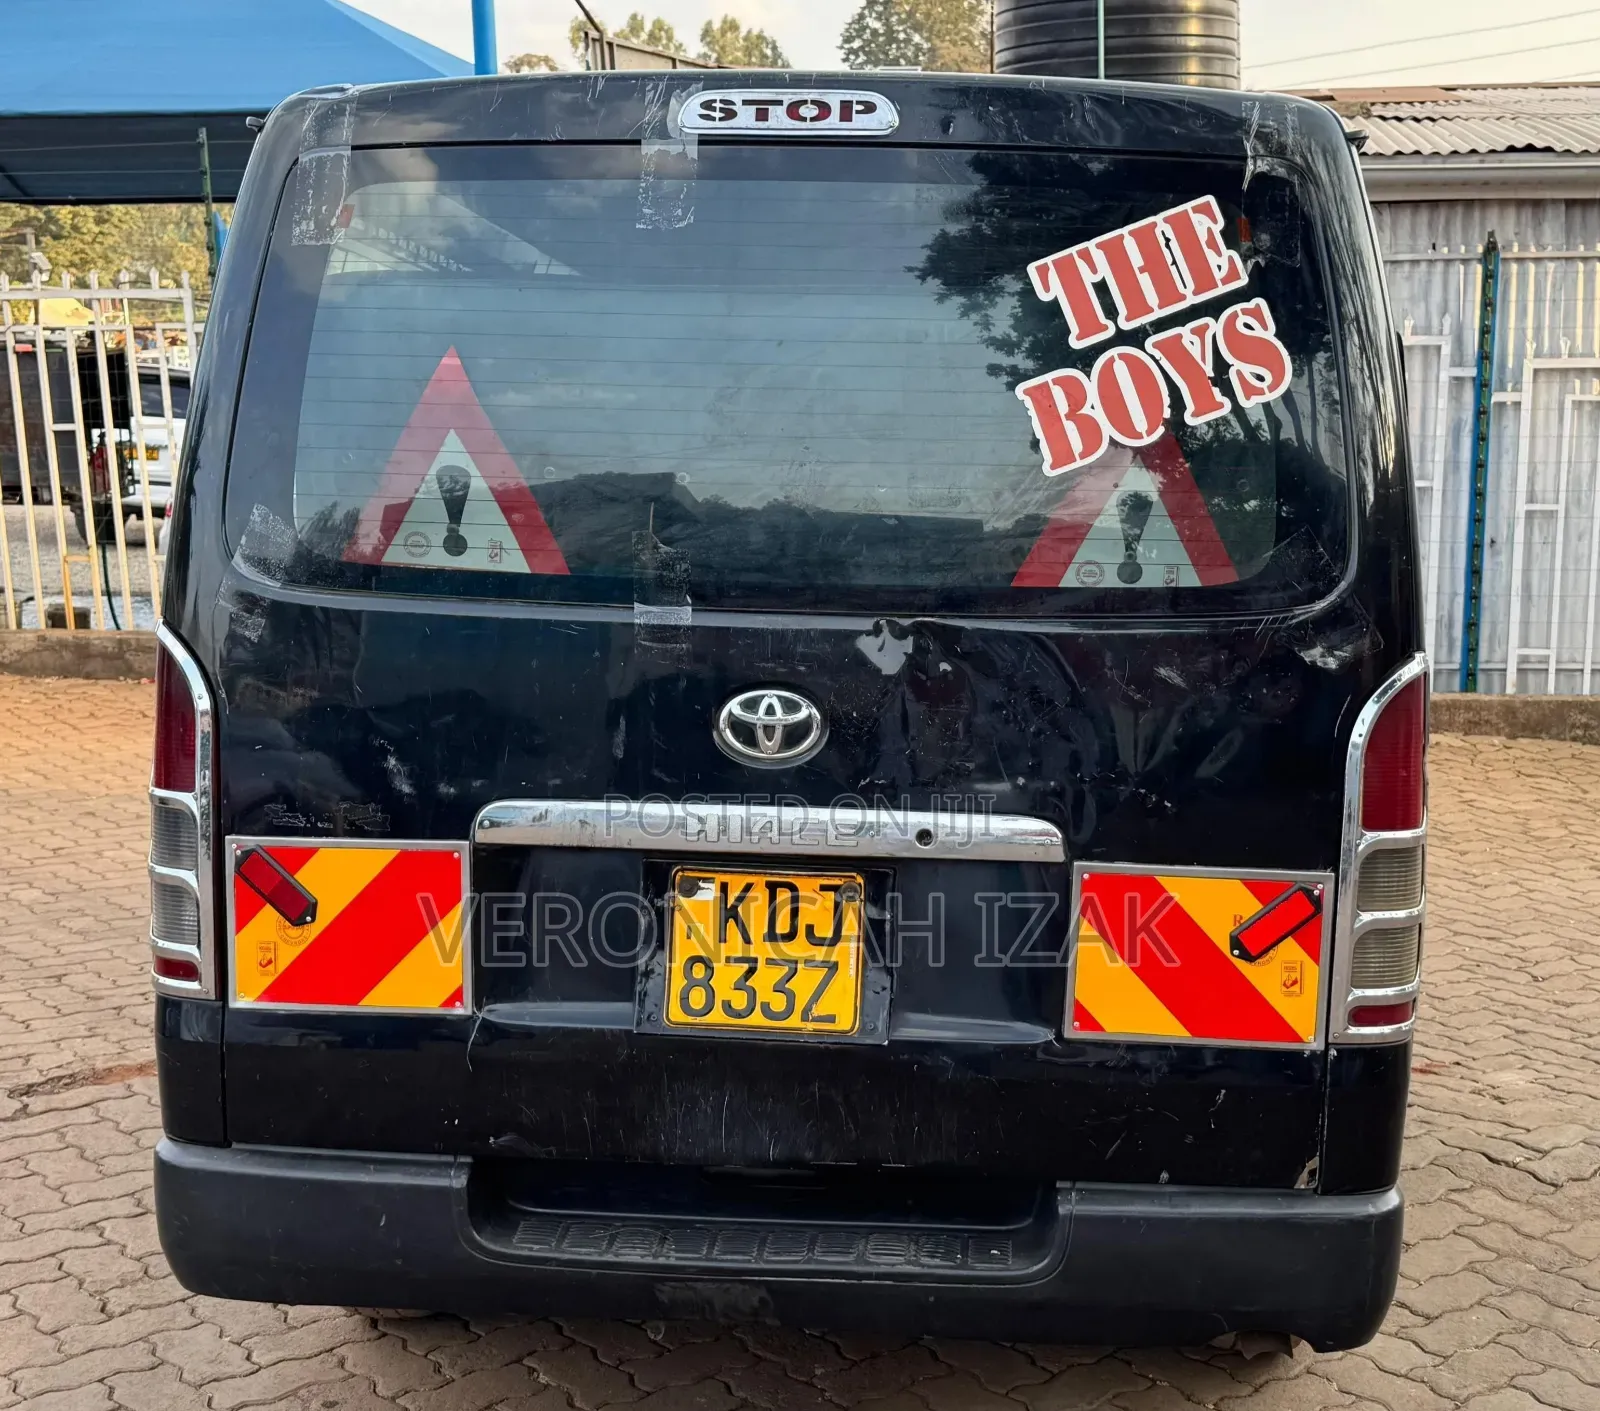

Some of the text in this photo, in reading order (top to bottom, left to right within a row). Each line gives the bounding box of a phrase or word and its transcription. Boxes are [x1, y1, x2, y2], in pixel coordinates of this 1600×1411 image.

[697, 98, 878, 122] STOP
[1028, 195, 1248, 349] THE
[1015, 298, 1292, 476] BOYS
[685, 813, 859, 847] HIACE
[718, 879, 843, 947] KDJ
[680, 954, 839, 1024] 833Z
